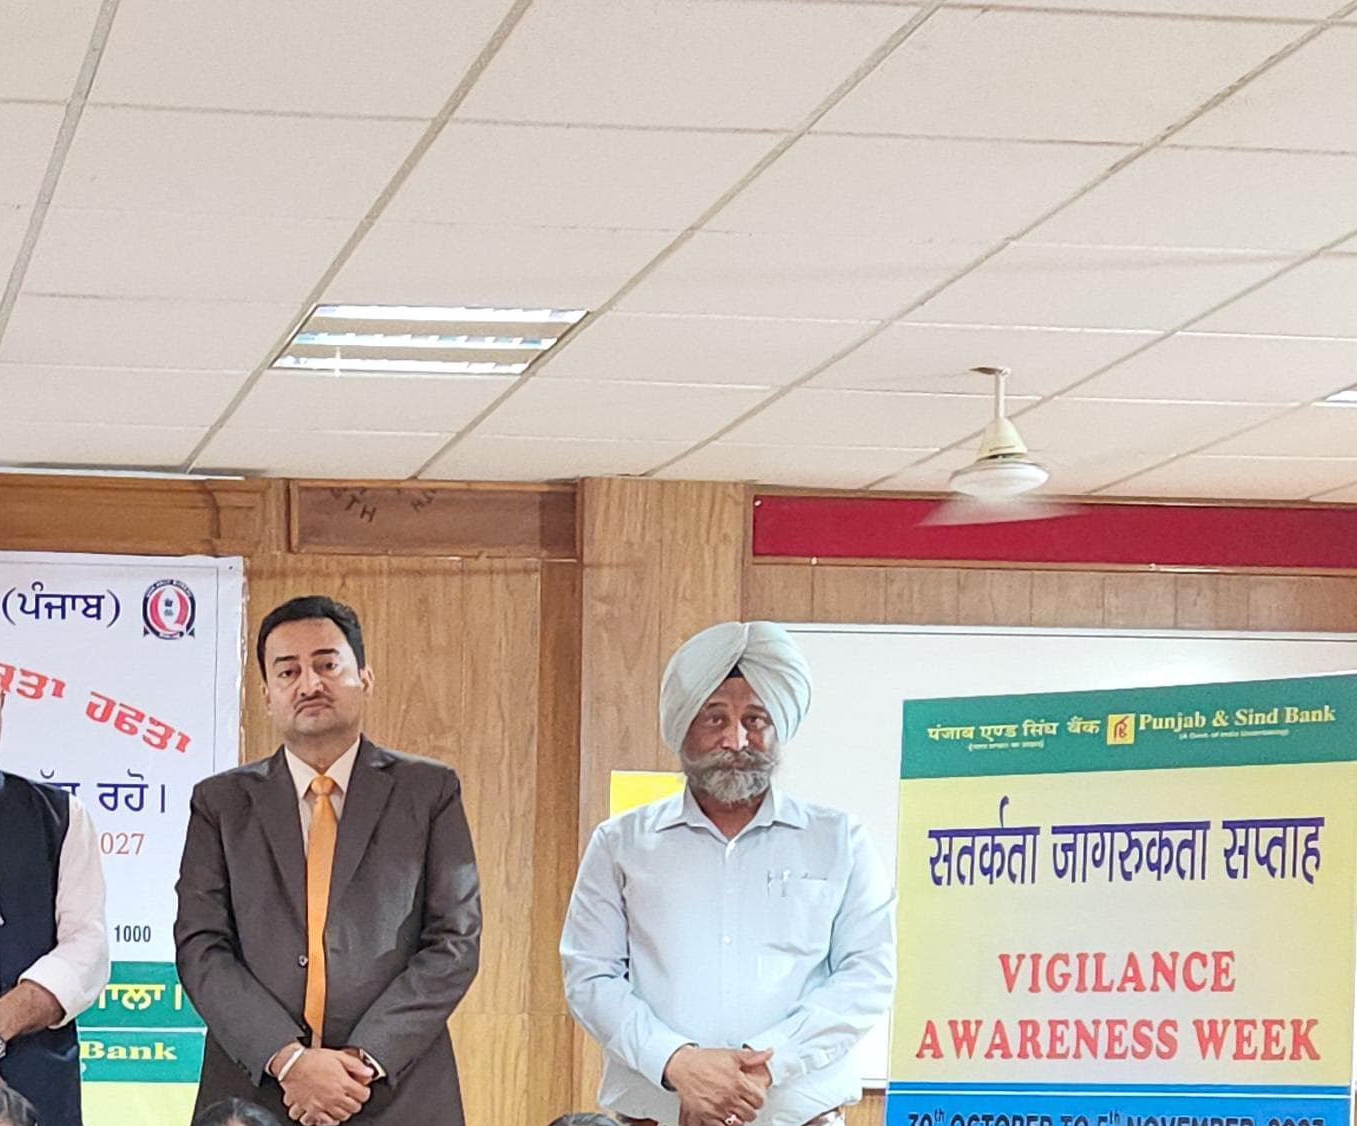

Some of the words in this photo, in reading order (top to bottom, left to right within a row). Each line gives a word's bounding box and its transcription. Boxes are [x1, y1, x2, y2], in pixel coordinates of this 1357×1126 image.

[2, 581, 121, 628] (ਪੰਜਾਬ)
[927, 724, 975, 741] पंजाब
[1067, 715, 1102, 735] बैंक
[1139, 710, 1206, 733] Punjab
[1212, 709, 1229, 728] &
[1235, 707, 1279, 727] Sind
[1284, 705, 1336, 724] Bank
[928, 796, 1041, 886] सतर्कता
[1222, 817, 1325, 884] सप्ताह
[114, 924, 152, 943] 1000
[998, 951, 1235, 993] VIGILANCE
[79, 1040, 177, 1060] Bank
[916, 1018, 1178, 1060] AWARENESS
[1193, 1018, 1321, 1061] WEEK
